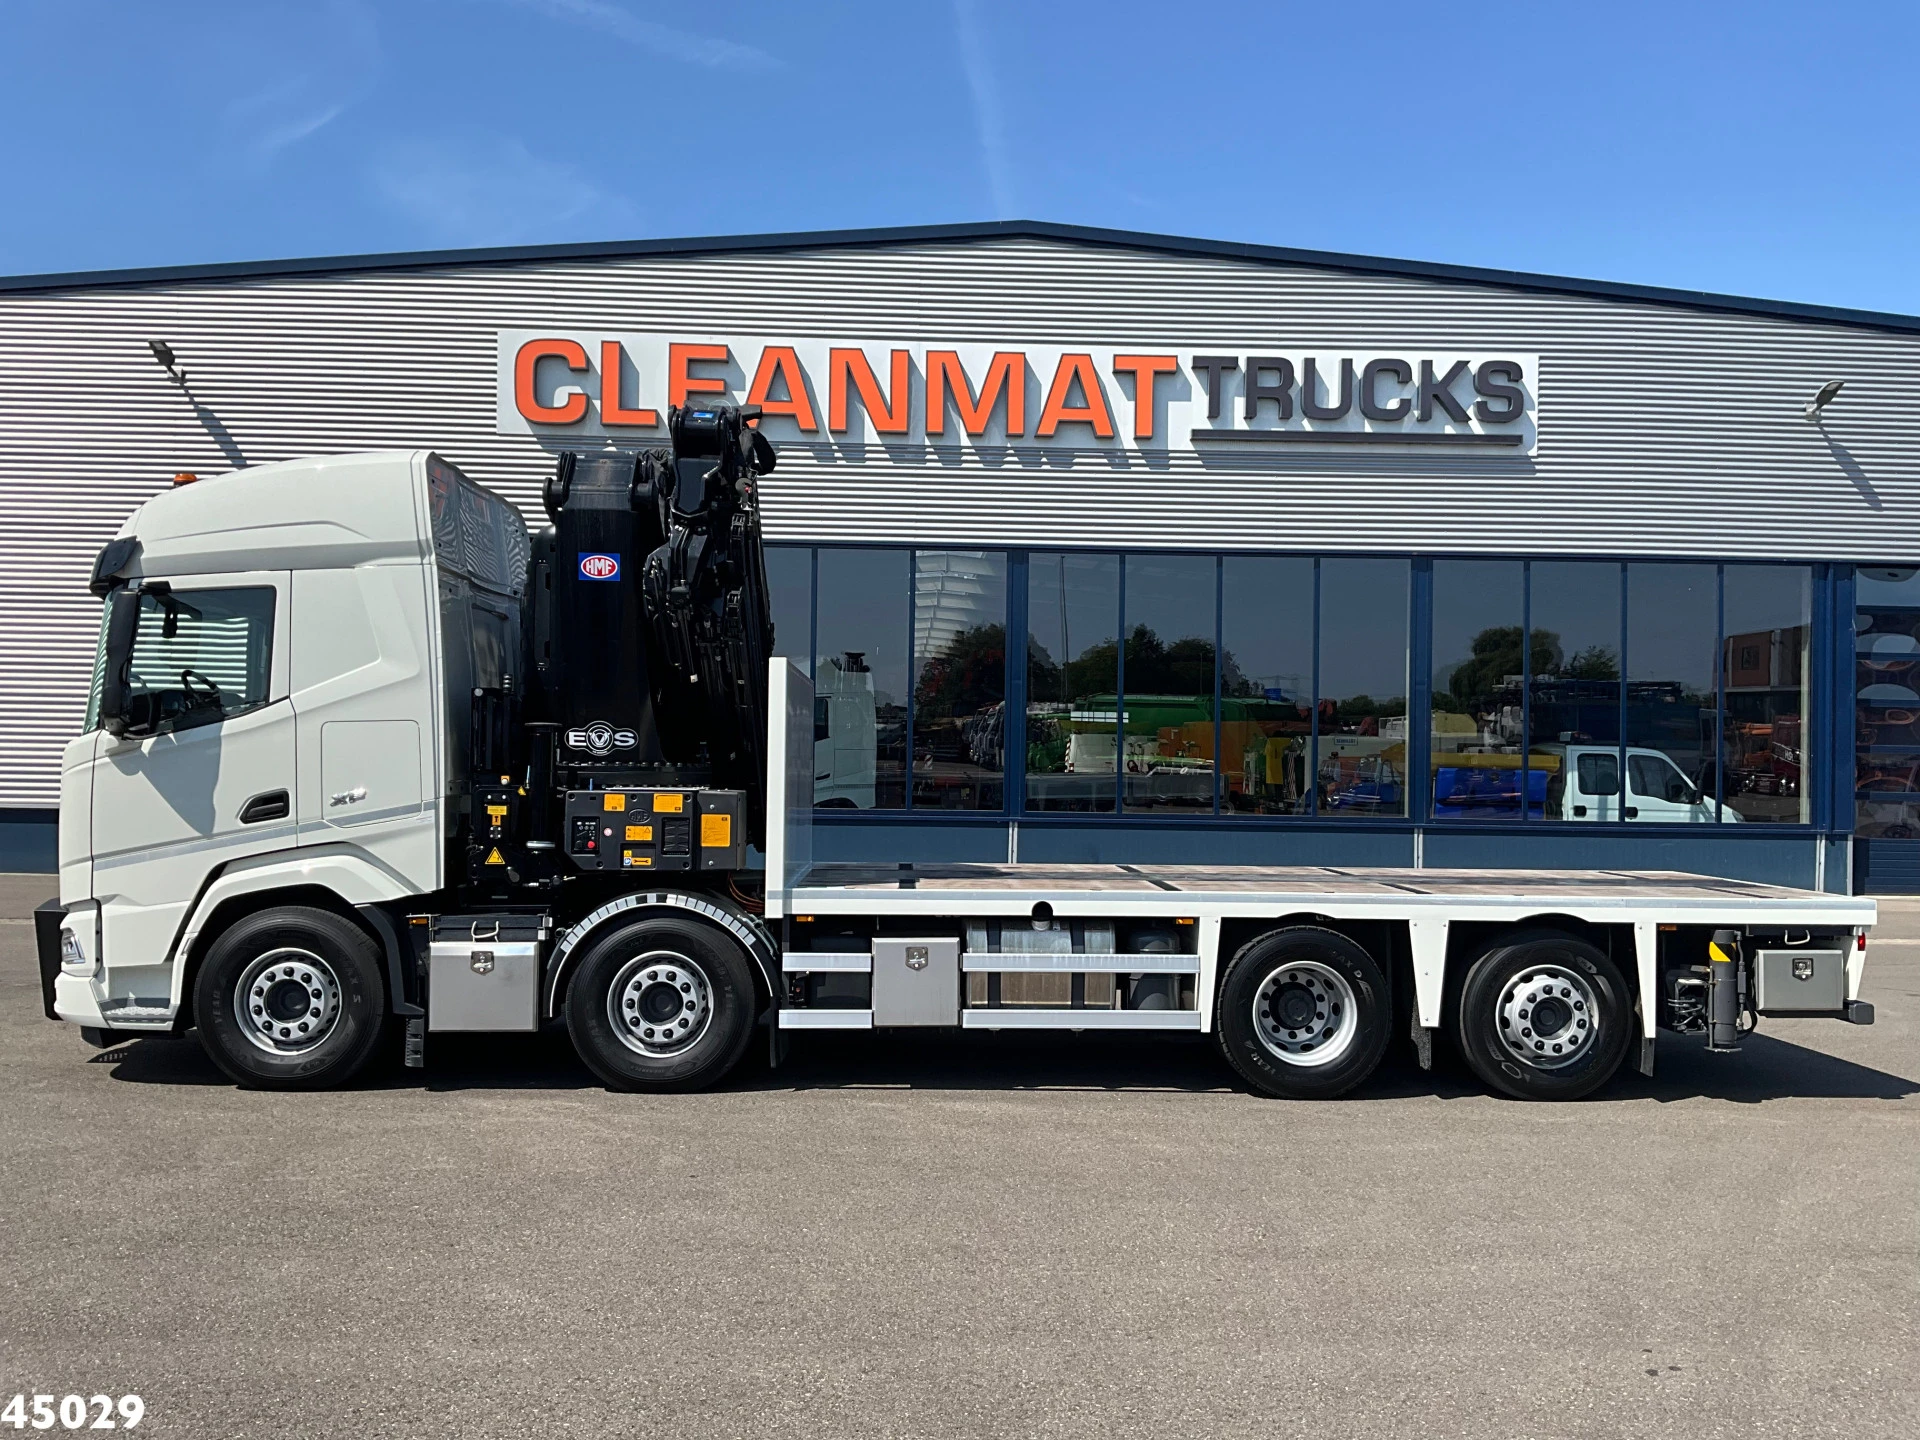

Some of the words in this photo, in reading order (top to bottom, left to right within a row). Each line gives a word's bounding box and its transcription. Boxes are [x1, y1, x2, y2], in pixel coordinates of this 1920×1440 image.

[514, 338, 1178, 440] CLEANMAT
[1192, 355, 1524, 424] TRUCKS
[585, 558, 613, 576] HMF
